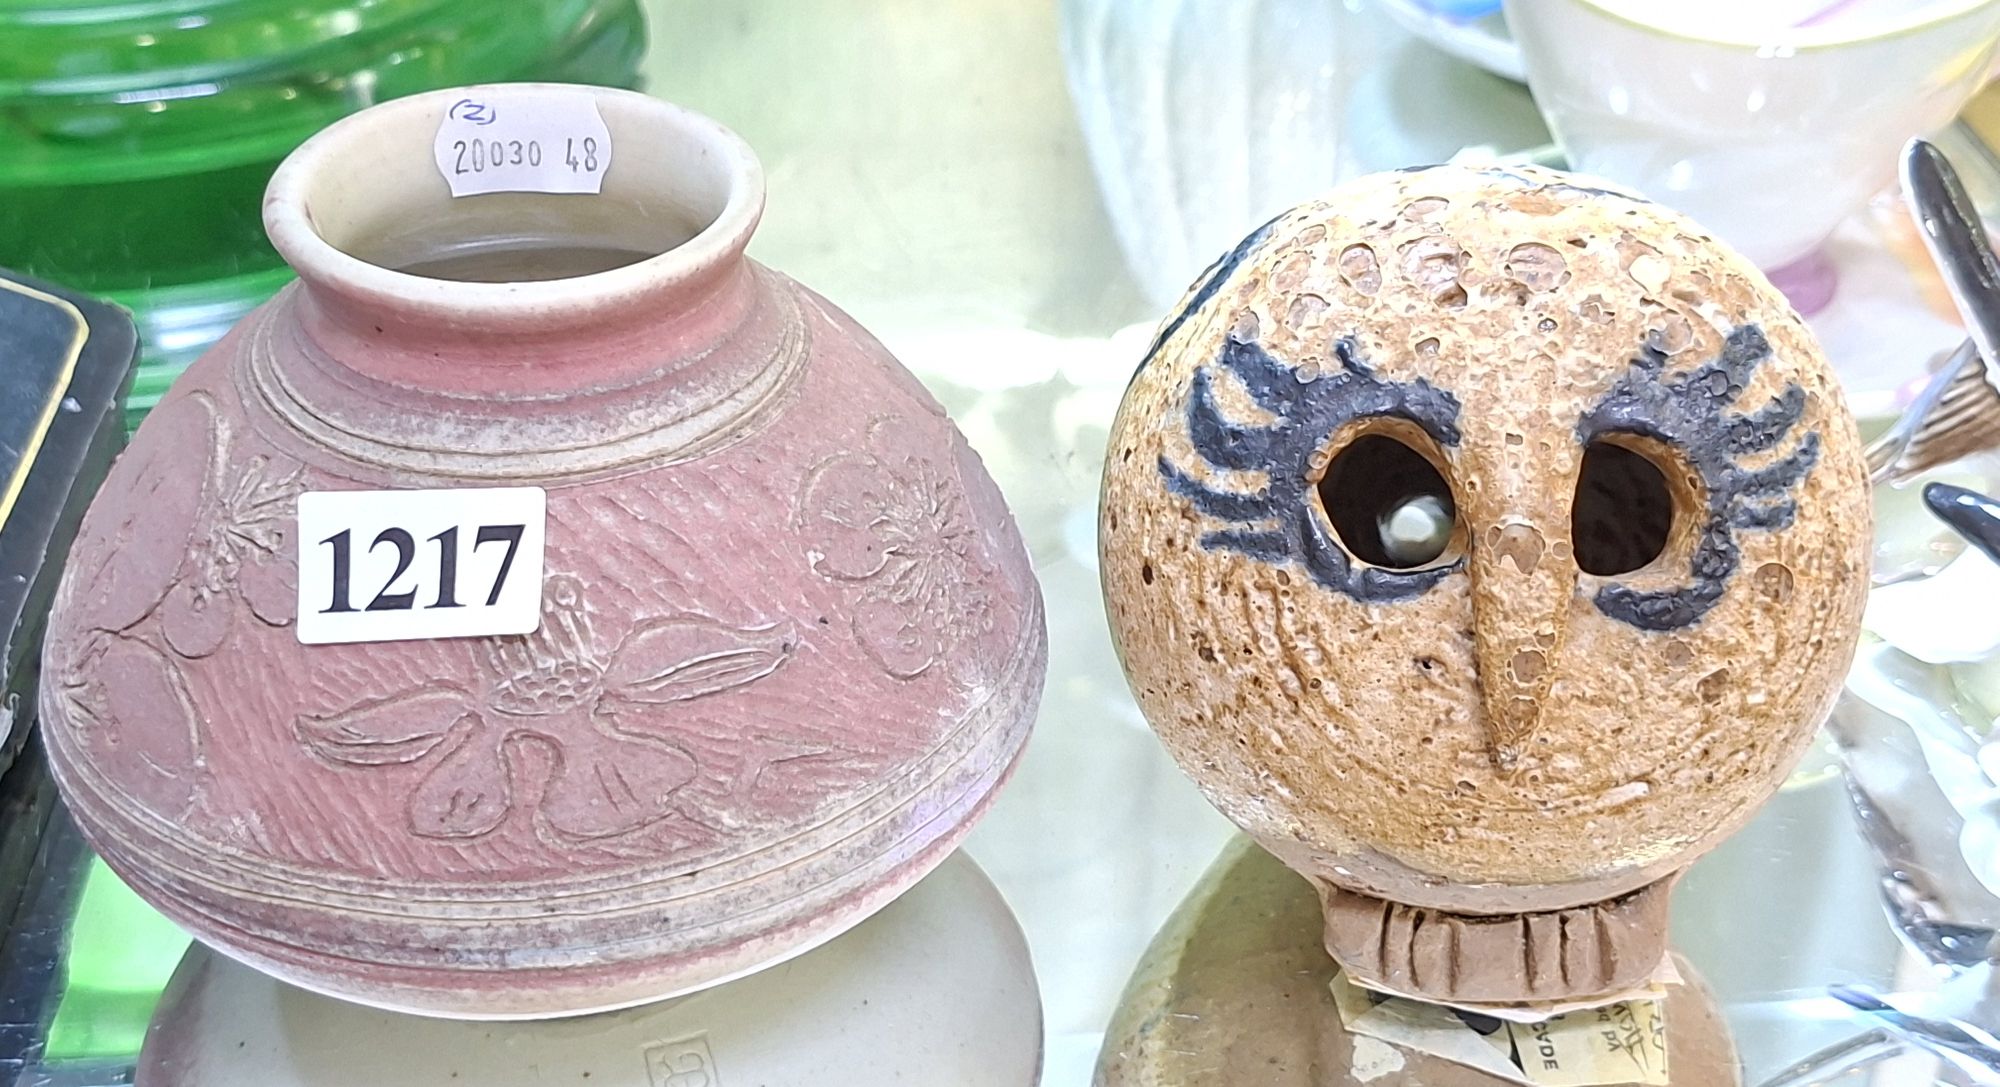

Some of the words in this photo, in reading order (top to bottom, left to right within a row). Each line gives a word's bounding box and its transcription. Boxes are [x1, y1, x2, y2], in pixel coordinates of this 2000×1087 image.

[453, 138, 542, 175] 20030
[565, 136, 598, 173] 48
[318, 524, 527, 614] 1217
